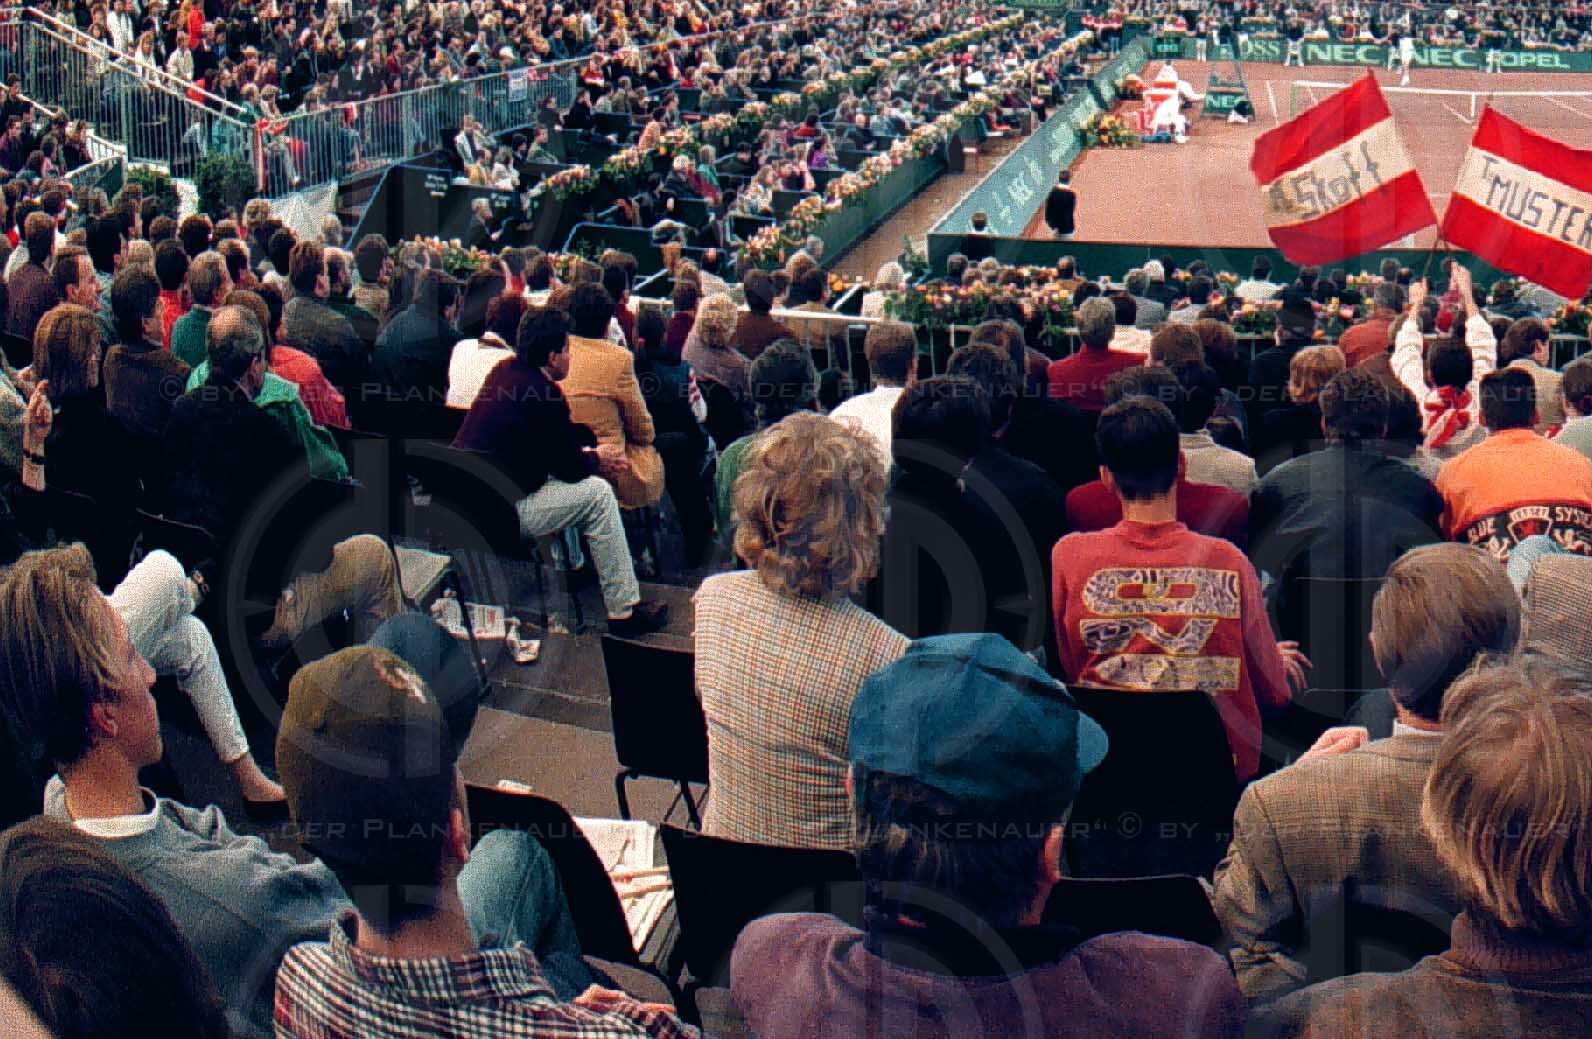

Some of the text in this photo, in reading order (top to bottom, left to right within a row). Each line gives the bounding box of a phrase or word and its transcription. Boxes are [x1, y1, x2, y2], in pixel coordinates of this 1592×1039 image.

[1241, 38, 1280, 58] OSS
[1307, 43, 1382, 64] NEC
[1411, 47, 1479, 67] NEC
[1500, 51, 1571, 69] OPEL
